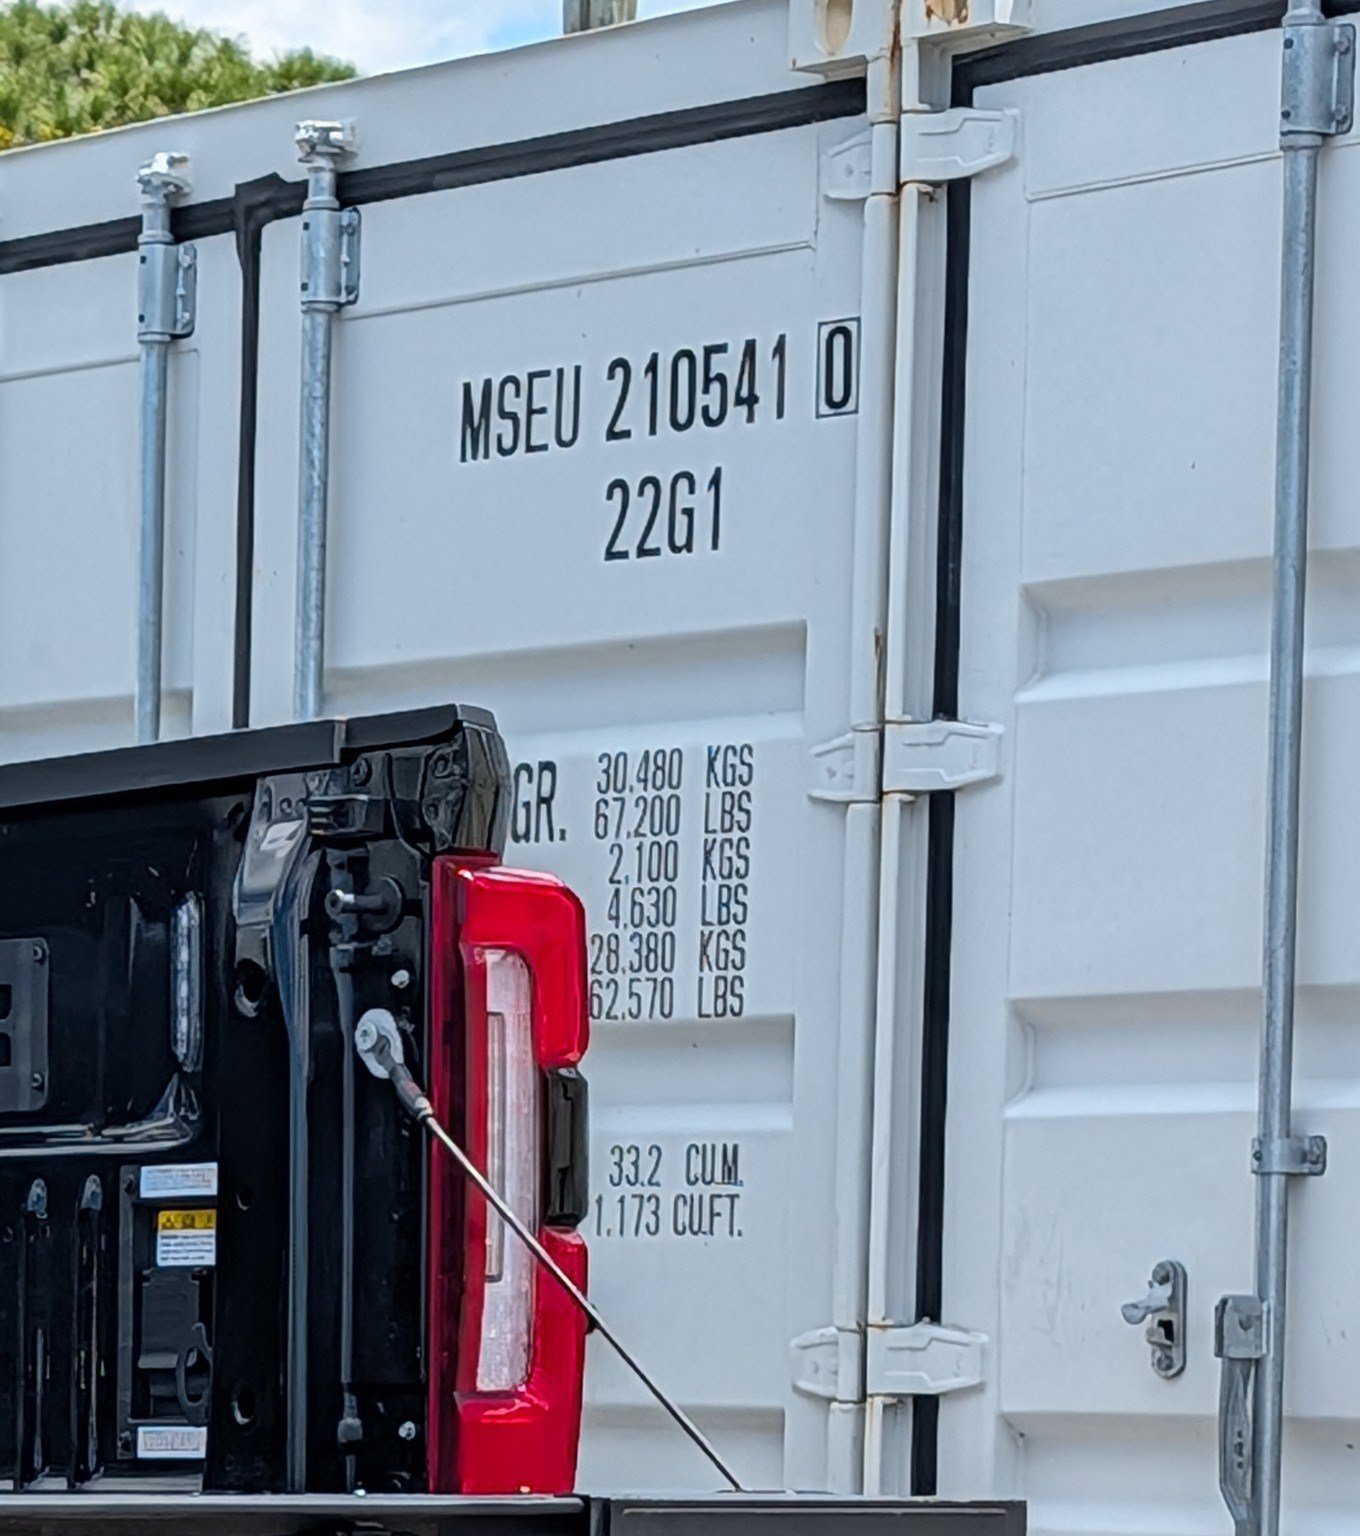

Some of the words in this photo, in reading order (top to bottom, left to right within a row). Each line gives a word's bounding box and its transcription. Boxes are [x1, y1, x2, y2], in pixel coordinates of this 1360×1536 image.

[459, 364, 582, 463] MSEU
[604, 333, 787, 441] 210541
[822, 323, 855, 412] 0
[603, 466, 722, 561] 22G1
[705, 743, 754, 789] KGS
[703, 790, 752, 835] LBS
[701, 836, 751, 881] KGS
[700, 882, 749, 927] LBS
[698, 929, 747, 973] KGS
[697, 974, 745, 1019] LBS
[608, 1144, 663, 1188] 33.2
